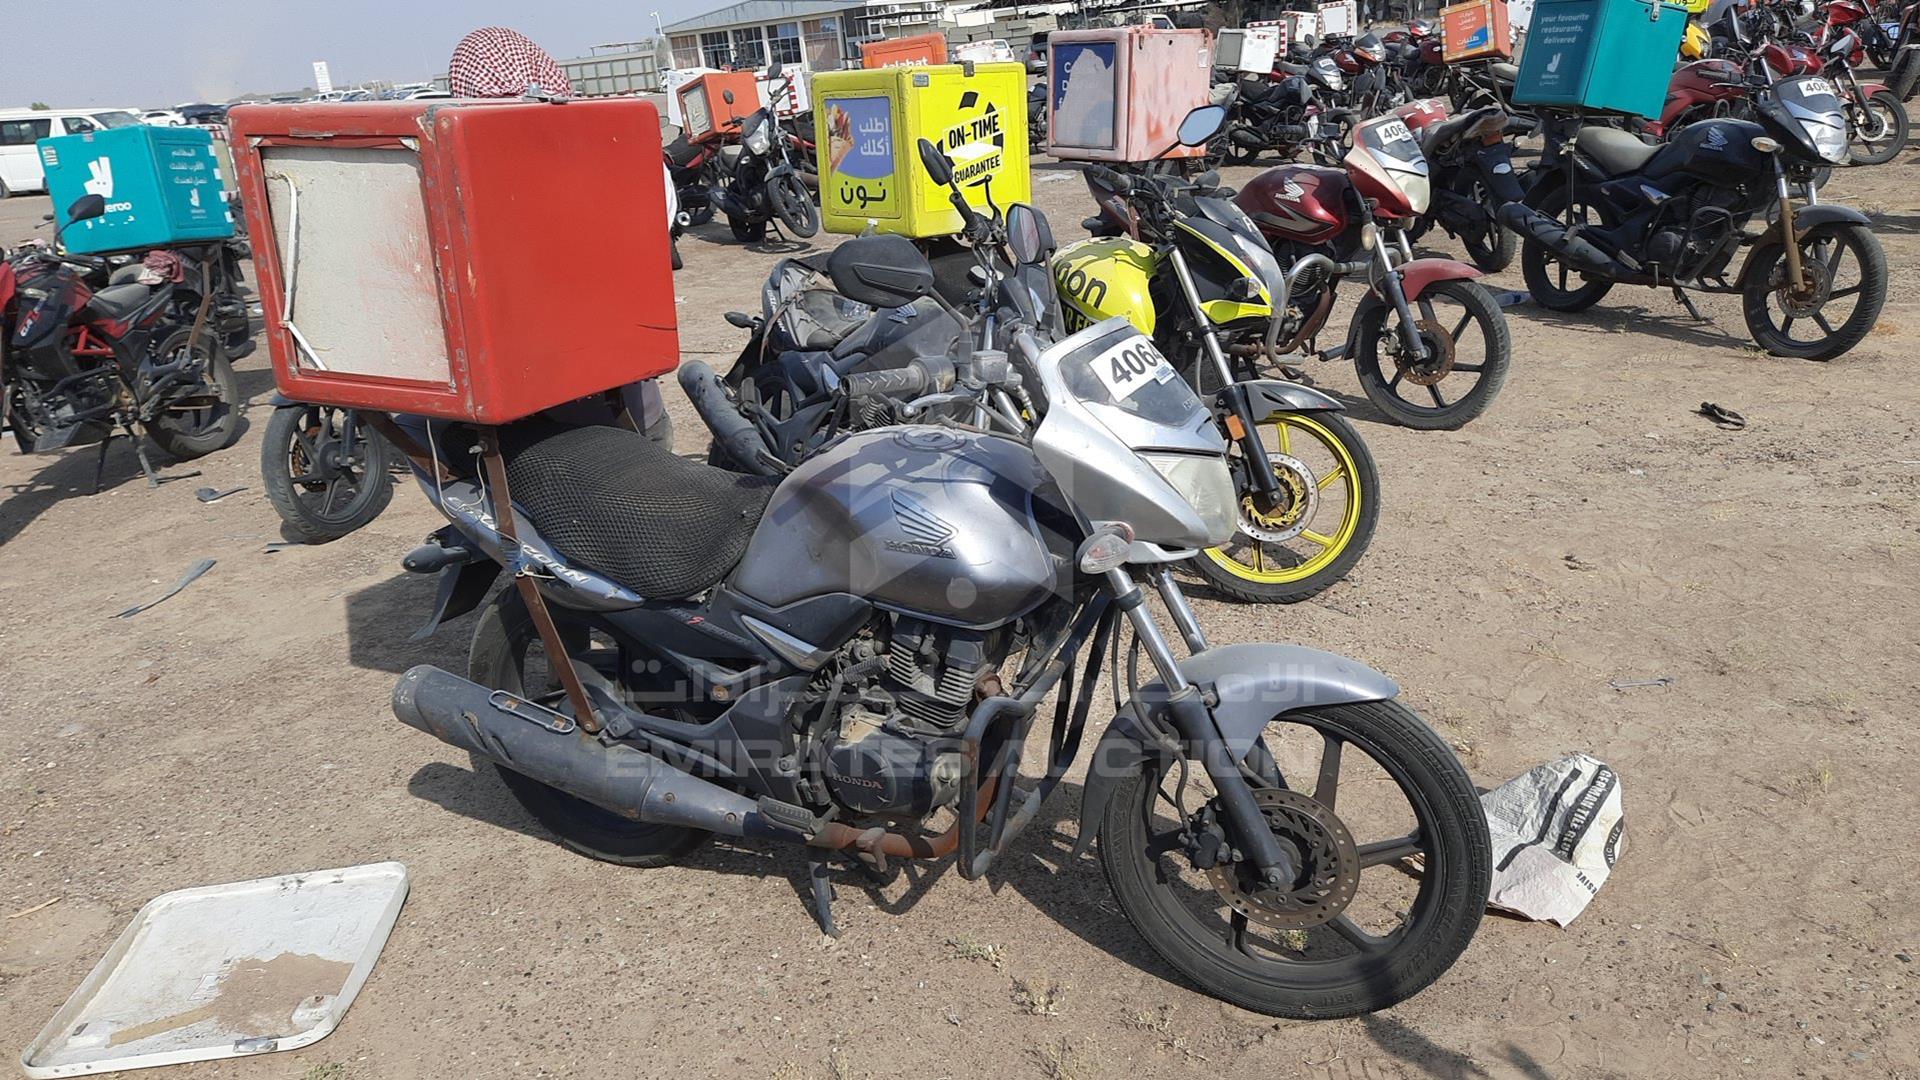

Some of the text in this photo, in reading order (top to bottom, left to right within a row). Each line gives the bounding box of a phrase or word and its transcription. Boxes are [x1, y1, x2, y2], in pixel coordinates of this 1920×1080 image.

[1541, 13, 1590, 24] your favourite
[1543, 35, 1577, 44] delivered
[1805, 80, 1829, 93] 406
[858, 117, 889, 134] اطلب
[948, 113, 1000, 150] ON-TIME
[1384, 124, 1408, 139] 406
[954, 154, 1001, 185] GUARANTEE
[840, 180, 887, 209] نون
[885, 540, 957, 560] HONDA
[832, 774, 884, 790] HONDA
